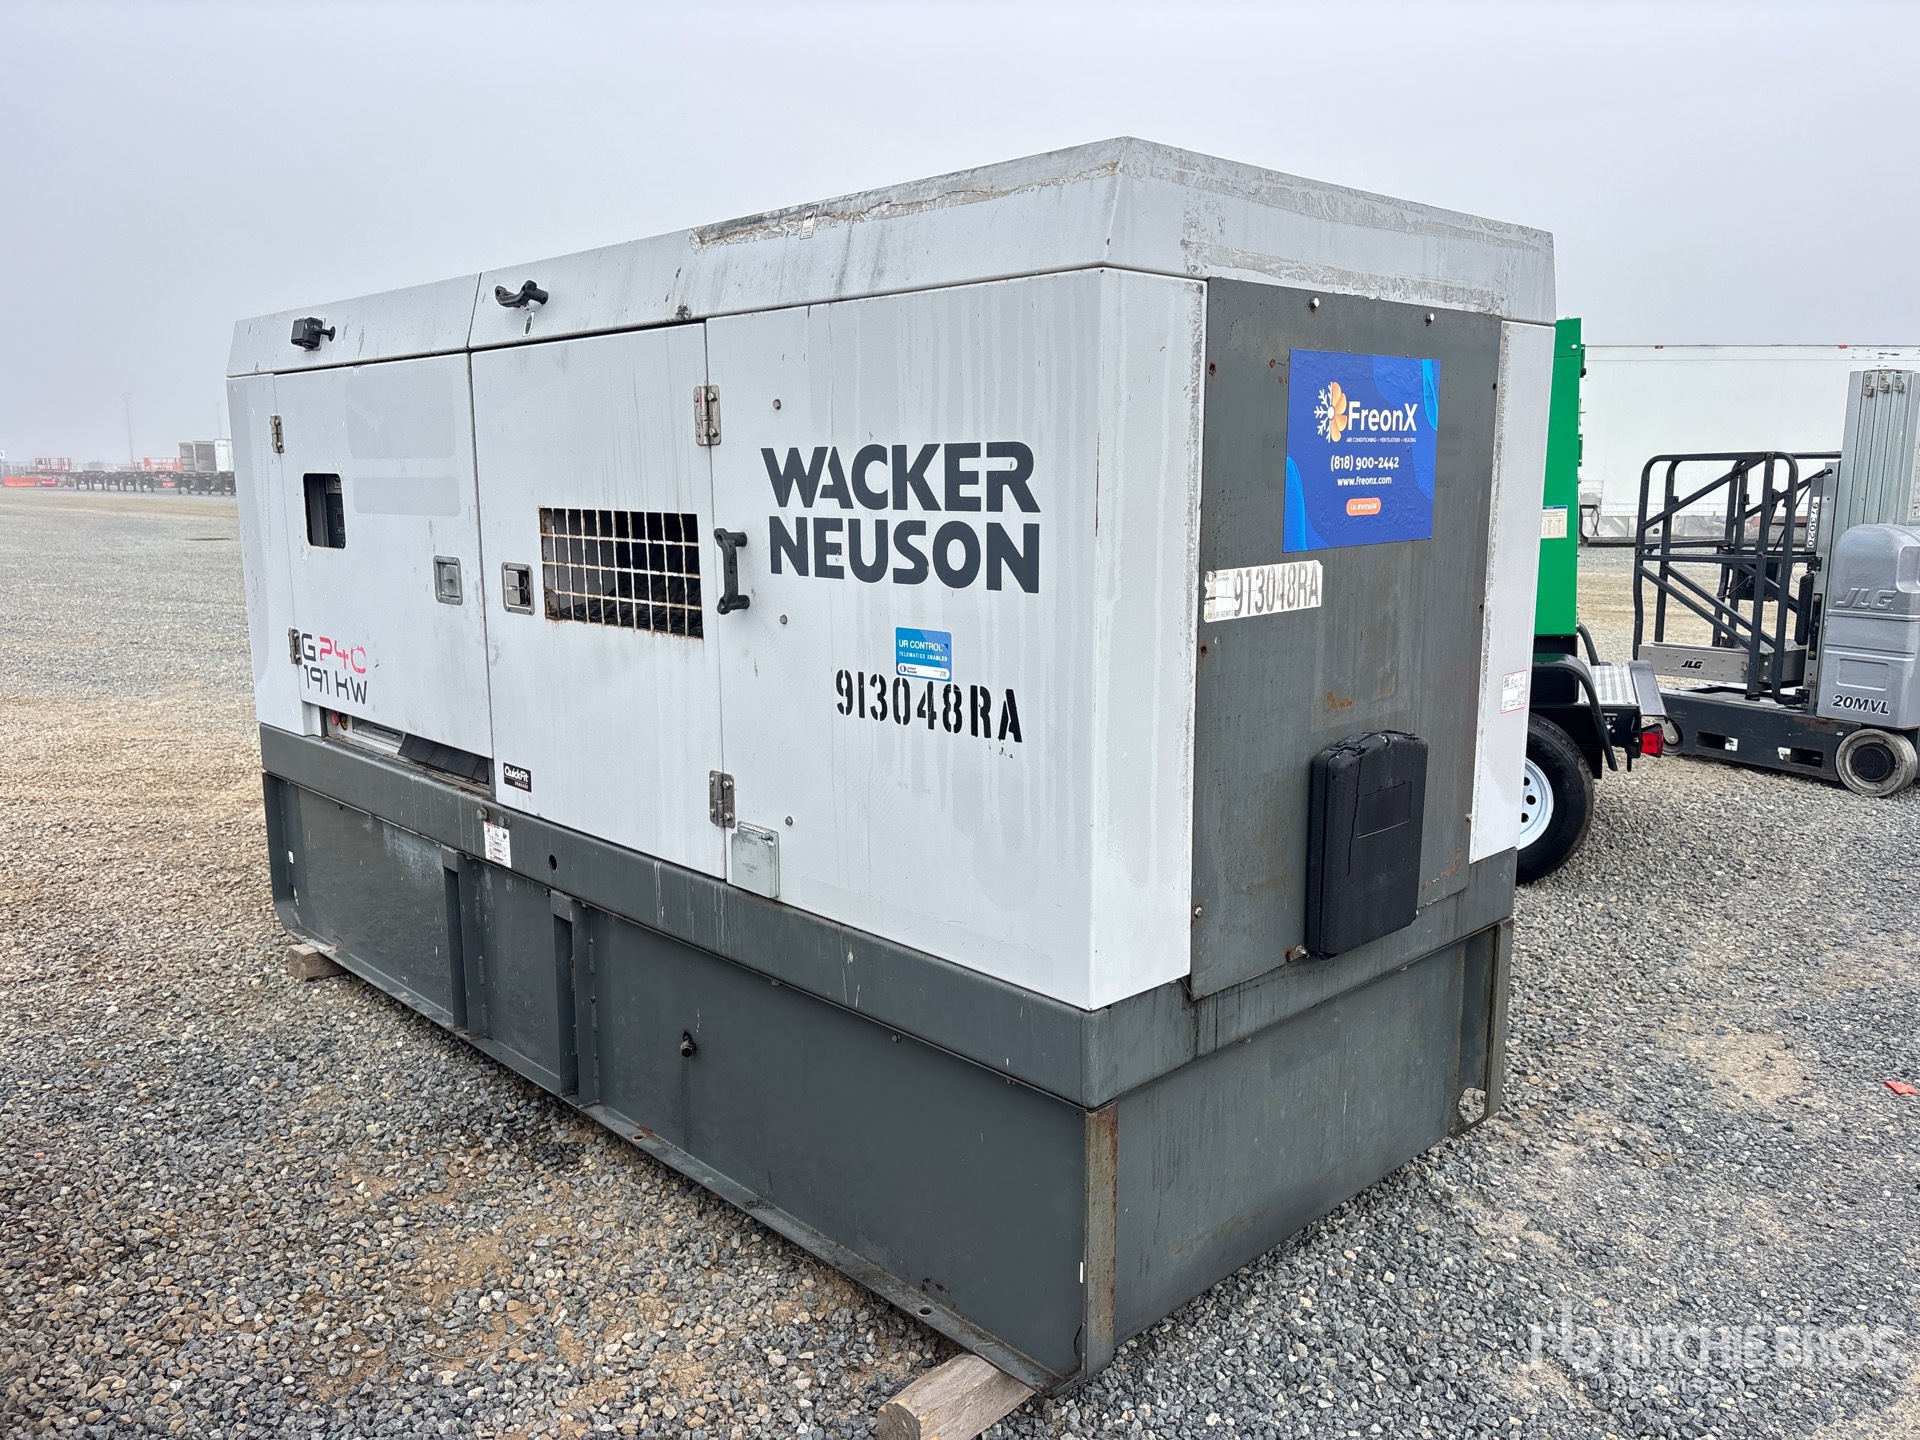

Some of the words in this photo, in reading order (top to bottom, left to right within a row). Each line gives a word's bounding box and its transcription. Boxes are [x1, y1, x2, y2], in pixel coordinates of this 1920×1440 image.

[1347, 400, 1418, 432] FreonX
[1330, 454, 1354, 472] (818)
[1355, 456, 1400, 471] 900-2442
[760, 441, 1042, 513] WACKER
[1337, 475, 1392, 487] www.freonx.com
[768, 515, 1040, 594] NEUSON
[1234, 561, 1320, 618] 913048RA
[1835, 587, 1897, 611] JLG
[898, 639, 909, 648] UR
[899, 651, 926, 659] TELEMATICS
[1681, 660, 1703, 669] JLG
[303, 664, 330, 695] 191
[835, 668, 1023, 744] 913048RA
[1832, 694, 1890, 715] 20MVL
[504, 765, 529, 782] QuickFit
